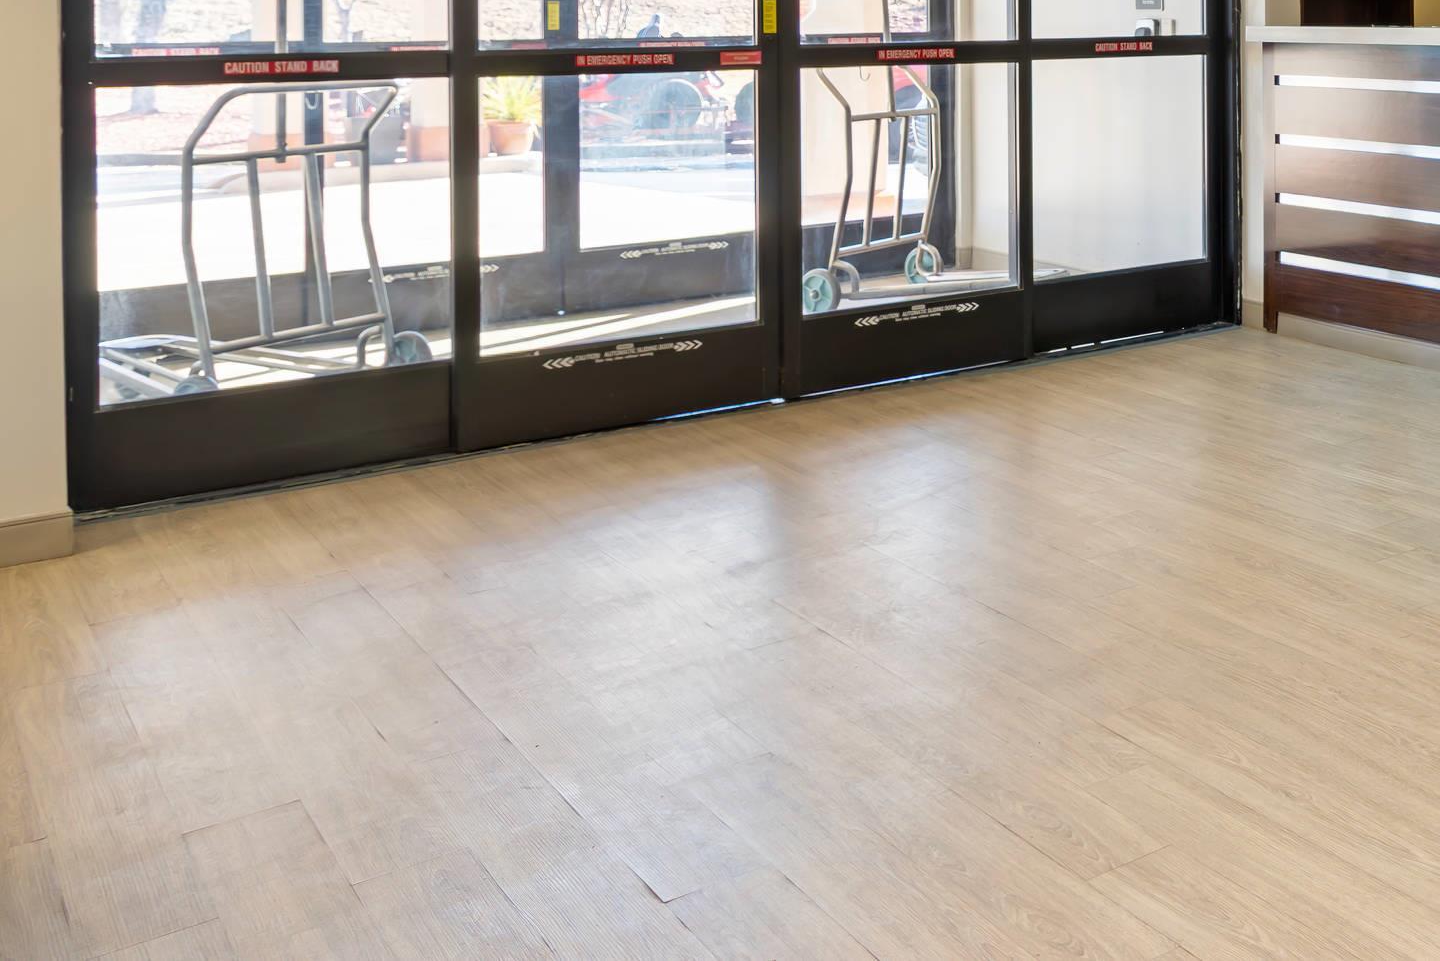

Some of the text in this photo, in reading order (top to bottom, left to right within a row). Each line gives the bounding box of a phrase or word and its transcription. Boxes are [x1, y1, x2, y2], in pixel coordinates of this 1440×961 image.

[1095, 41, 1152, 51] CAUTION STAND BACK
[577, 53, 674, 66] IN EMERGENCY PUSH OPEN
[878, 48, 955, 59] IN EMERGENCY PUSH OPEN
[225, 60, 339, 74] CAUTION STAND BACK
